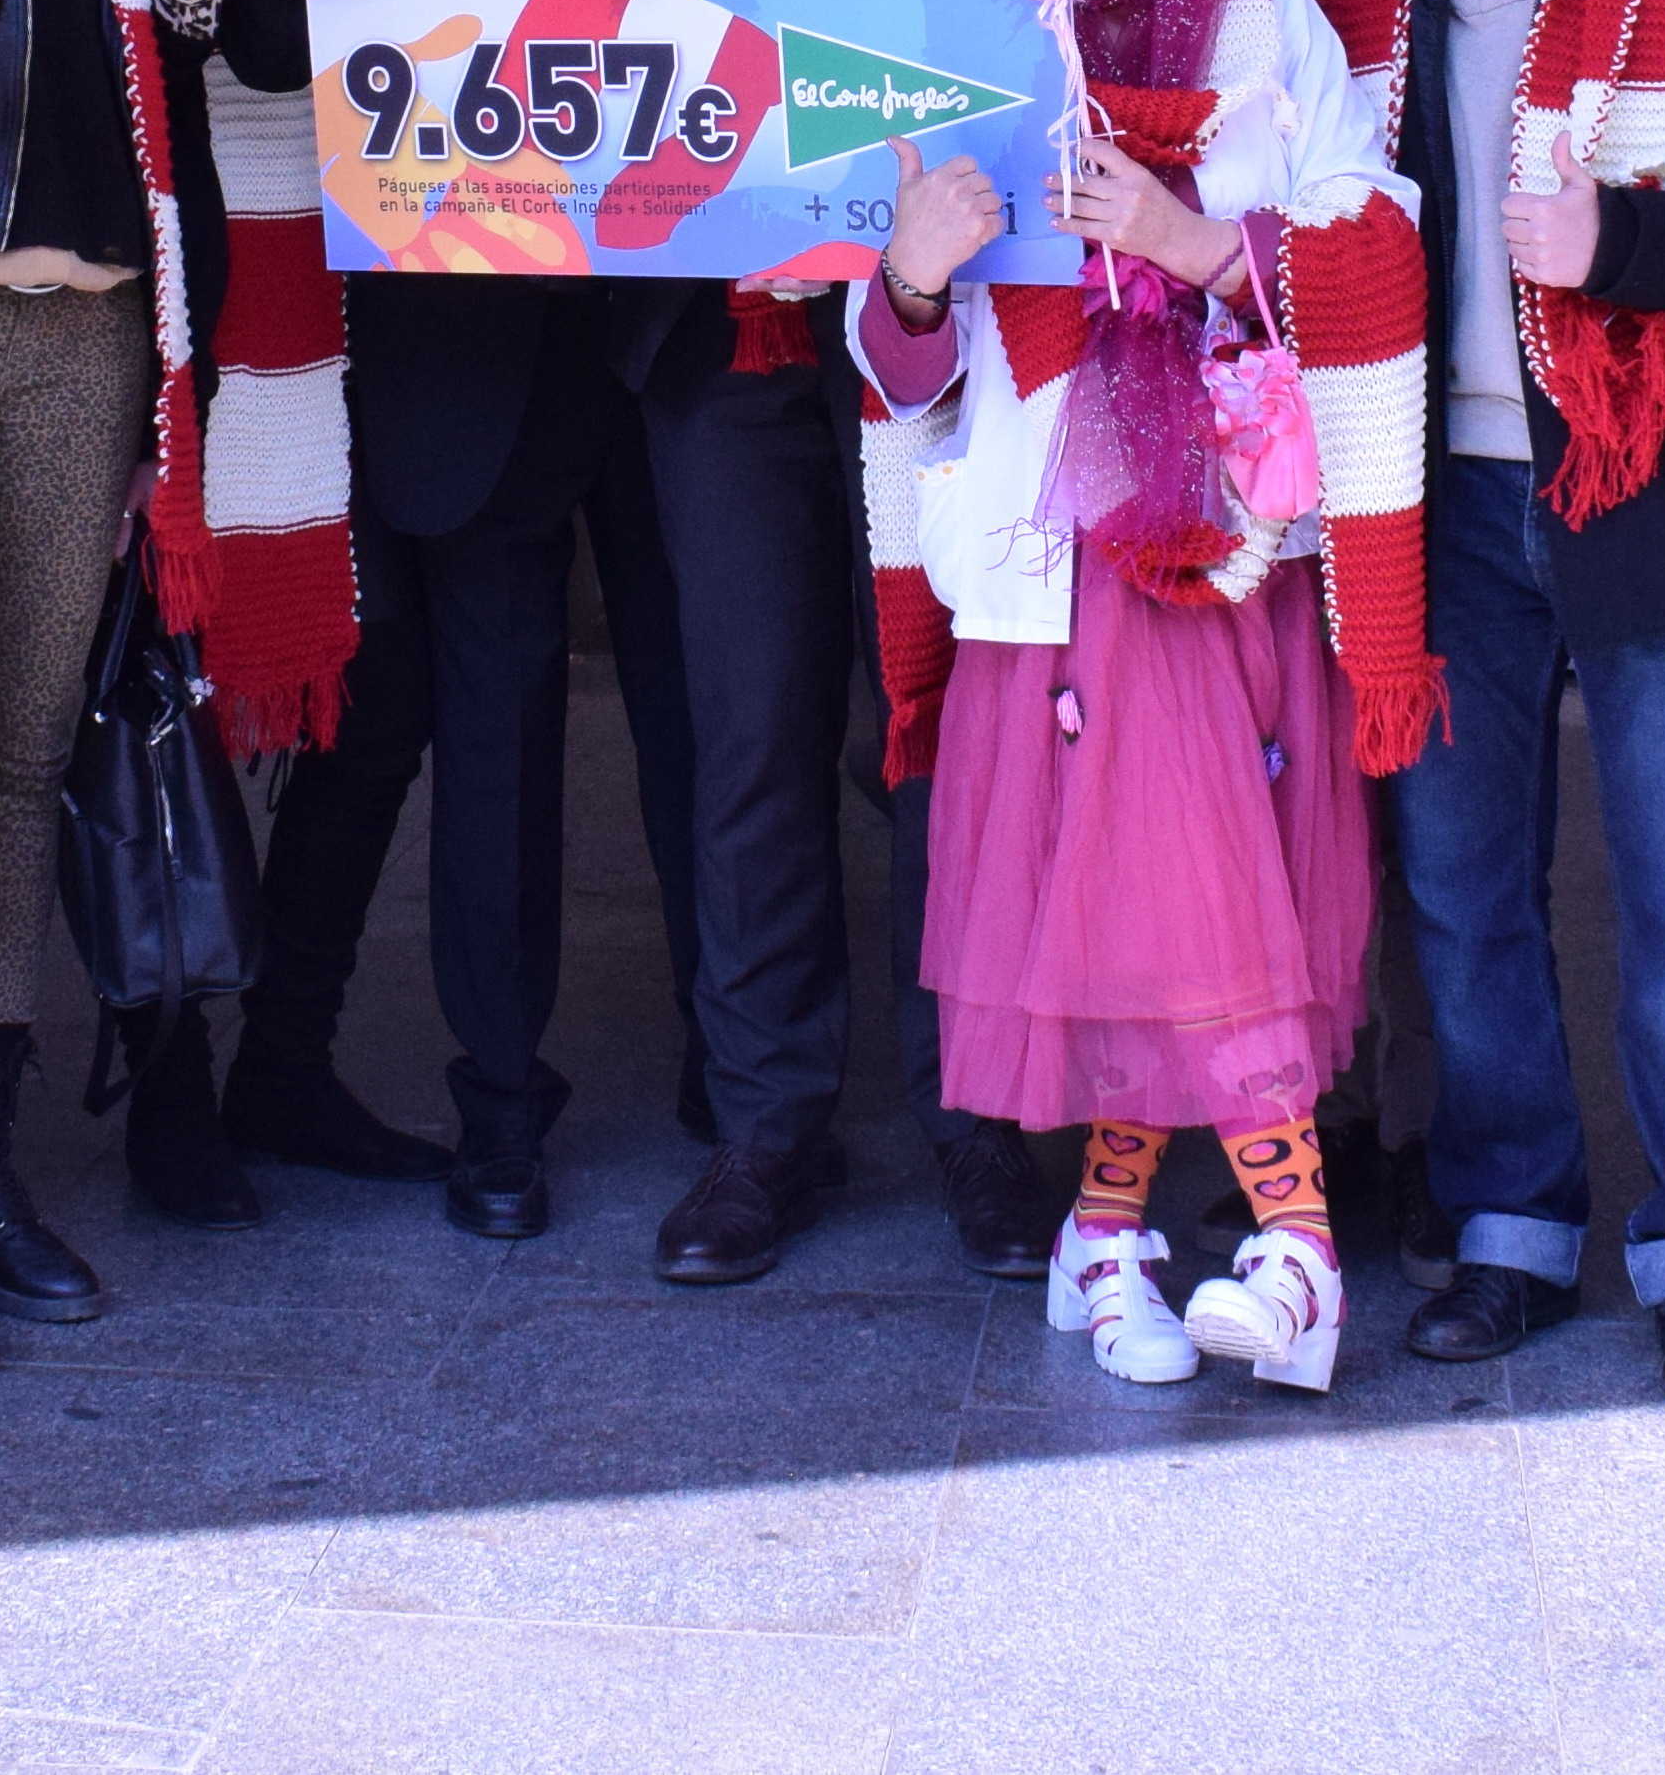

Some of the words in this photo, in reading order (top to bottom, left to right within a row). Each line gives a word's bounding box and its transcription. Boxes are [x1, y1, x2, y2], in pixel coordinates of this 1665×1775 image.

[791, 78, 819, 108] El
[819, 80, 879, 109] Corte
[882, 73, 970, 120] Inglés
[378, 178, 446, 195] Páguese
[451, 182, 460, 193] a
[465, 178, 489, 194] las
[494, 178, 598, 195] asociaciones
[603, 178, 711, 199] participantes
[379, 201, 398, 213] en
[404, 198, 419, 213] la
[424, 198, 495, 217] campaña
[501, 199, 517, 214] El
[523, 200, 567, 214] Corte
[573, 199, 623, 217] Inglés
[642, 199, 708, 216] Solidari
